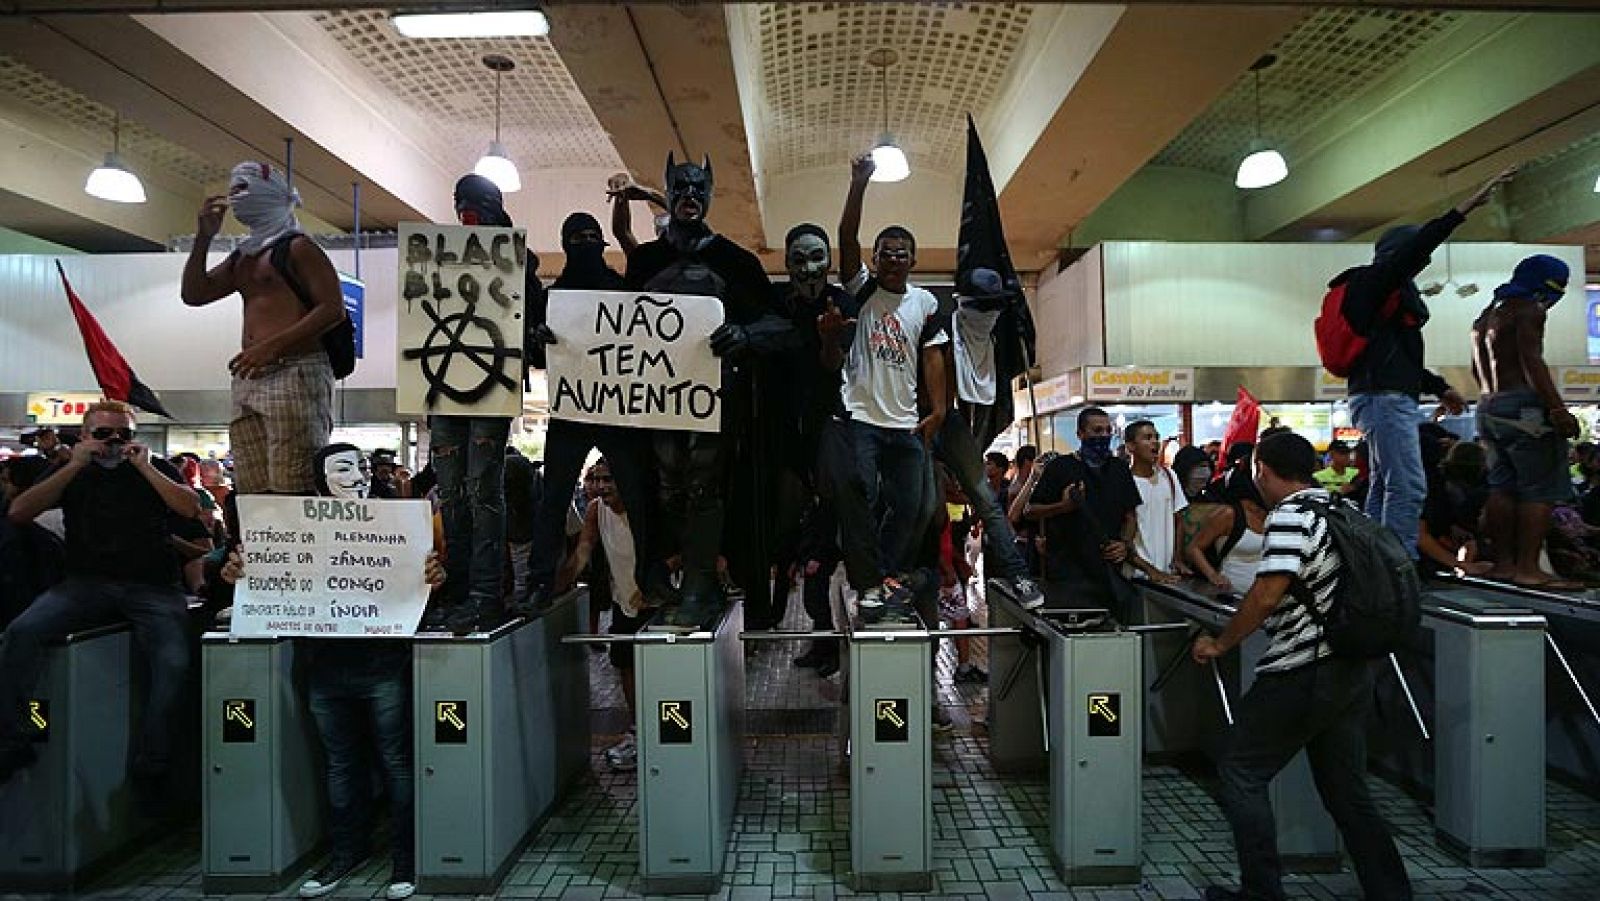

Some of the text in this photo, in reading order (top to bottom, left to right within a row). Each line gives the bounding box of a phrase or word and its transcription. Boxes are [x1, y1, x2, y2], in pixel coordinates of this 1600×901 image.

[596, 295, 684, 342] NÃO
[587, 343, 675, 378] TEM
[1093, 371, 1169, 385] Central
[552, 376, 716, 420] AUMENTO
[304, 500, 374, 521] BRASIL
[335, 532, 406, 544] ALEMANHA
[248, 547, 392, 567] SAÚDE DA ZÂMBIA
[327, 577, 384, 592] CONGO
[331, 599, 378, 617] ÍNDIA
